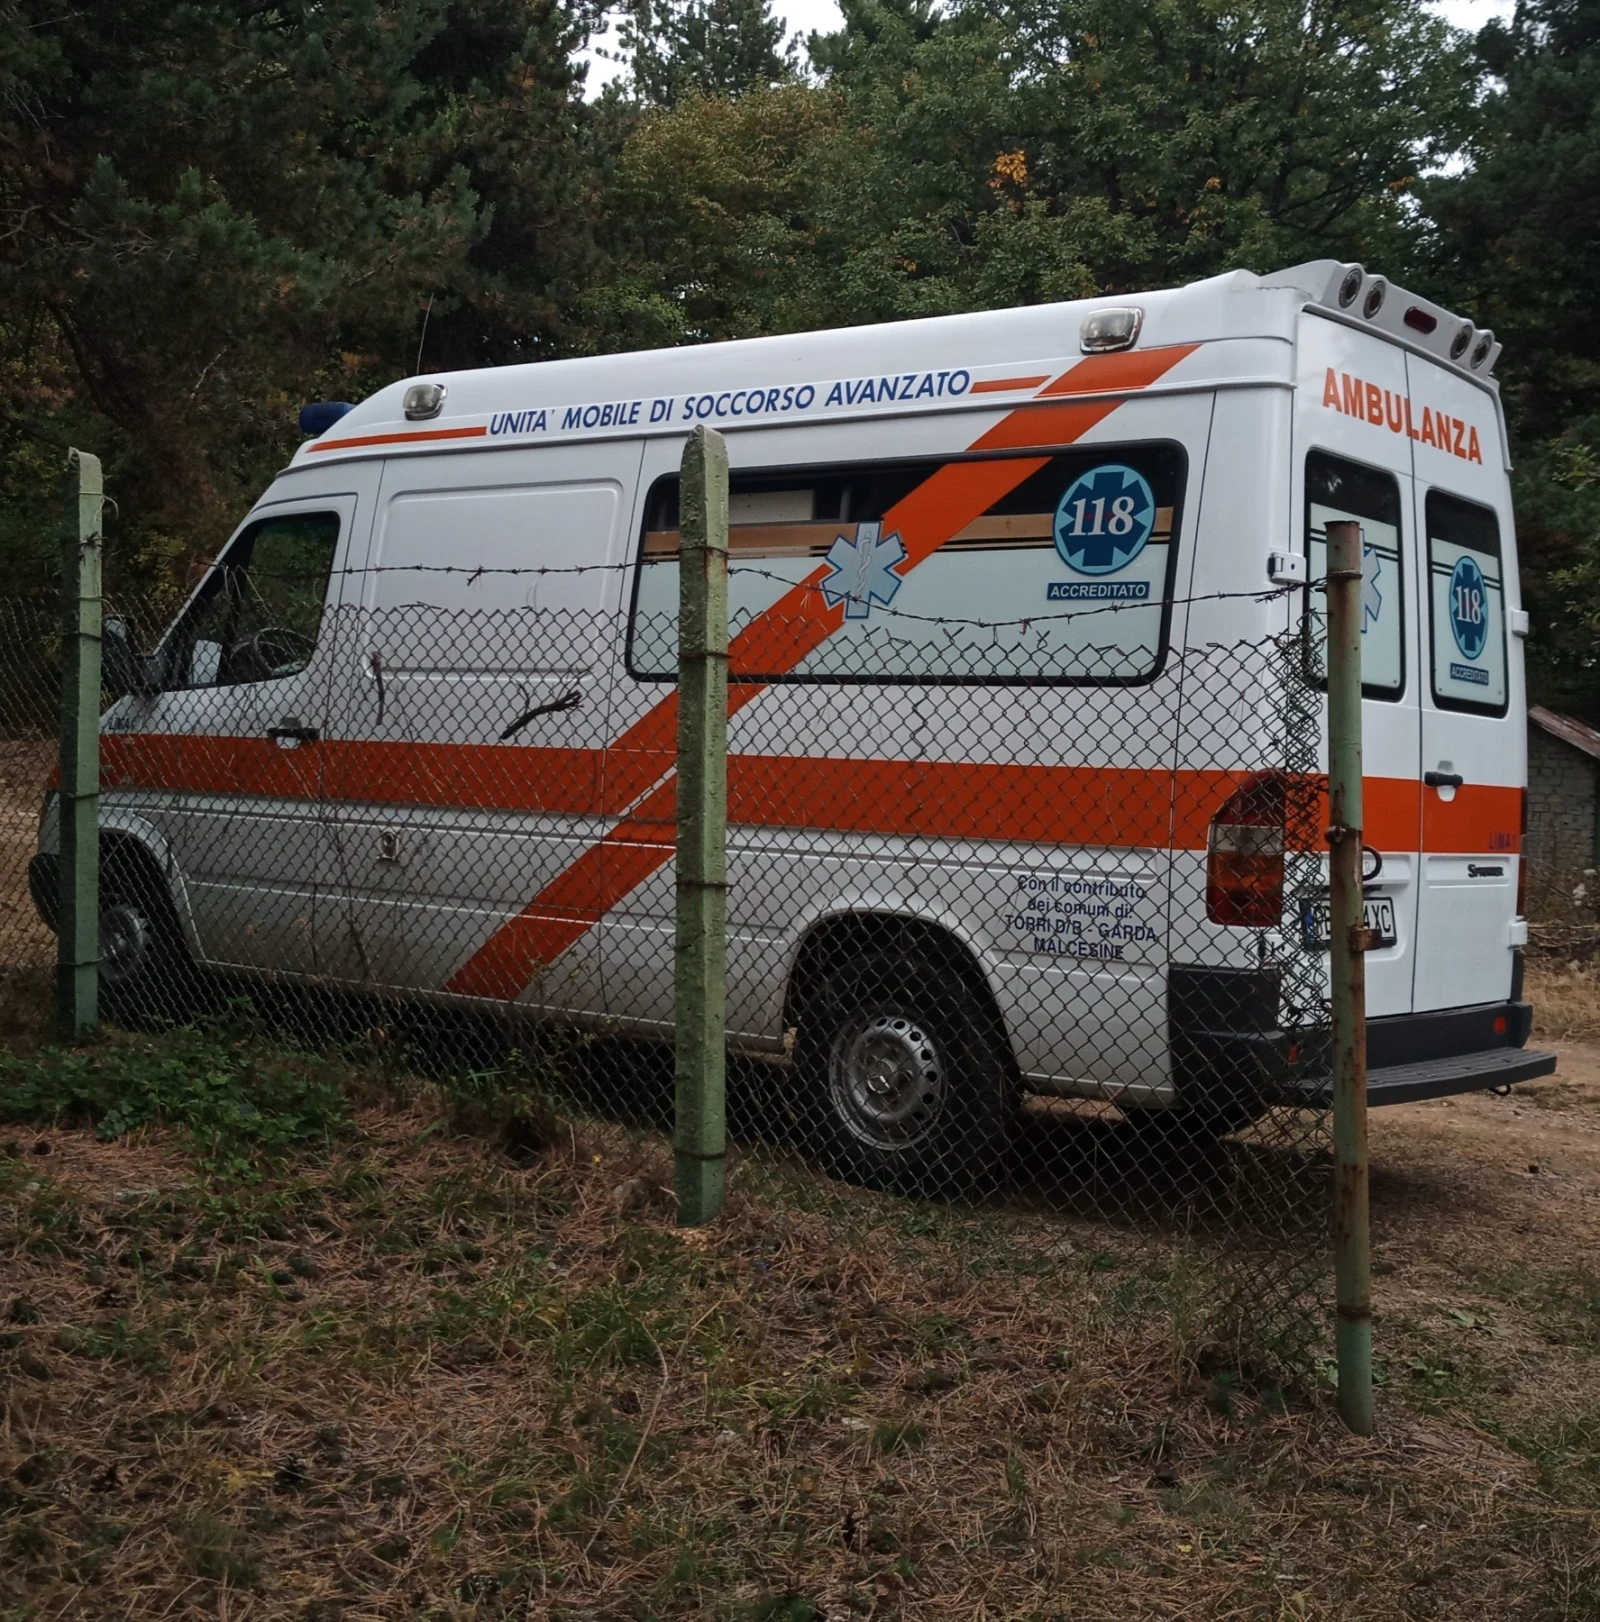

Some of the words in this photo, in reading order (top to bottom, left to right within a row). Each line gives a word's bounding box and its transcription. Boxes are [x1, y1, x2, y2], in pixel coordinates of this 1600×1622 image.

[561, 401, 642, 430] MOBILE
[649, 398, 674, 423] DI
[682, 385, 815, 420] SOCCORSO
[825, 370, 970, 406] AVANZATO
[1323, 367, 1483, 465] AMBULANZA
[1068, 496, 1135, 536] 118
[1050, 584, 1147, 598] ACCREDITATO
[1455, 585, 1482, 625] 118
[1017, 874, 1047, 892] Con
[1050, 876, 1059, 892] il
[1063, 880, 1146, 899] contributo
[1028, 897, 1050, 912] dei
[1054, 902, 1110, 917] comuni
[1005, 914, 1051, 933] TORRI
[1055, 919, 1082, 935] D/B
[1098, 922, 1157, 943] GARDA
[1034, 937, 1124, 960] MALCESINE
